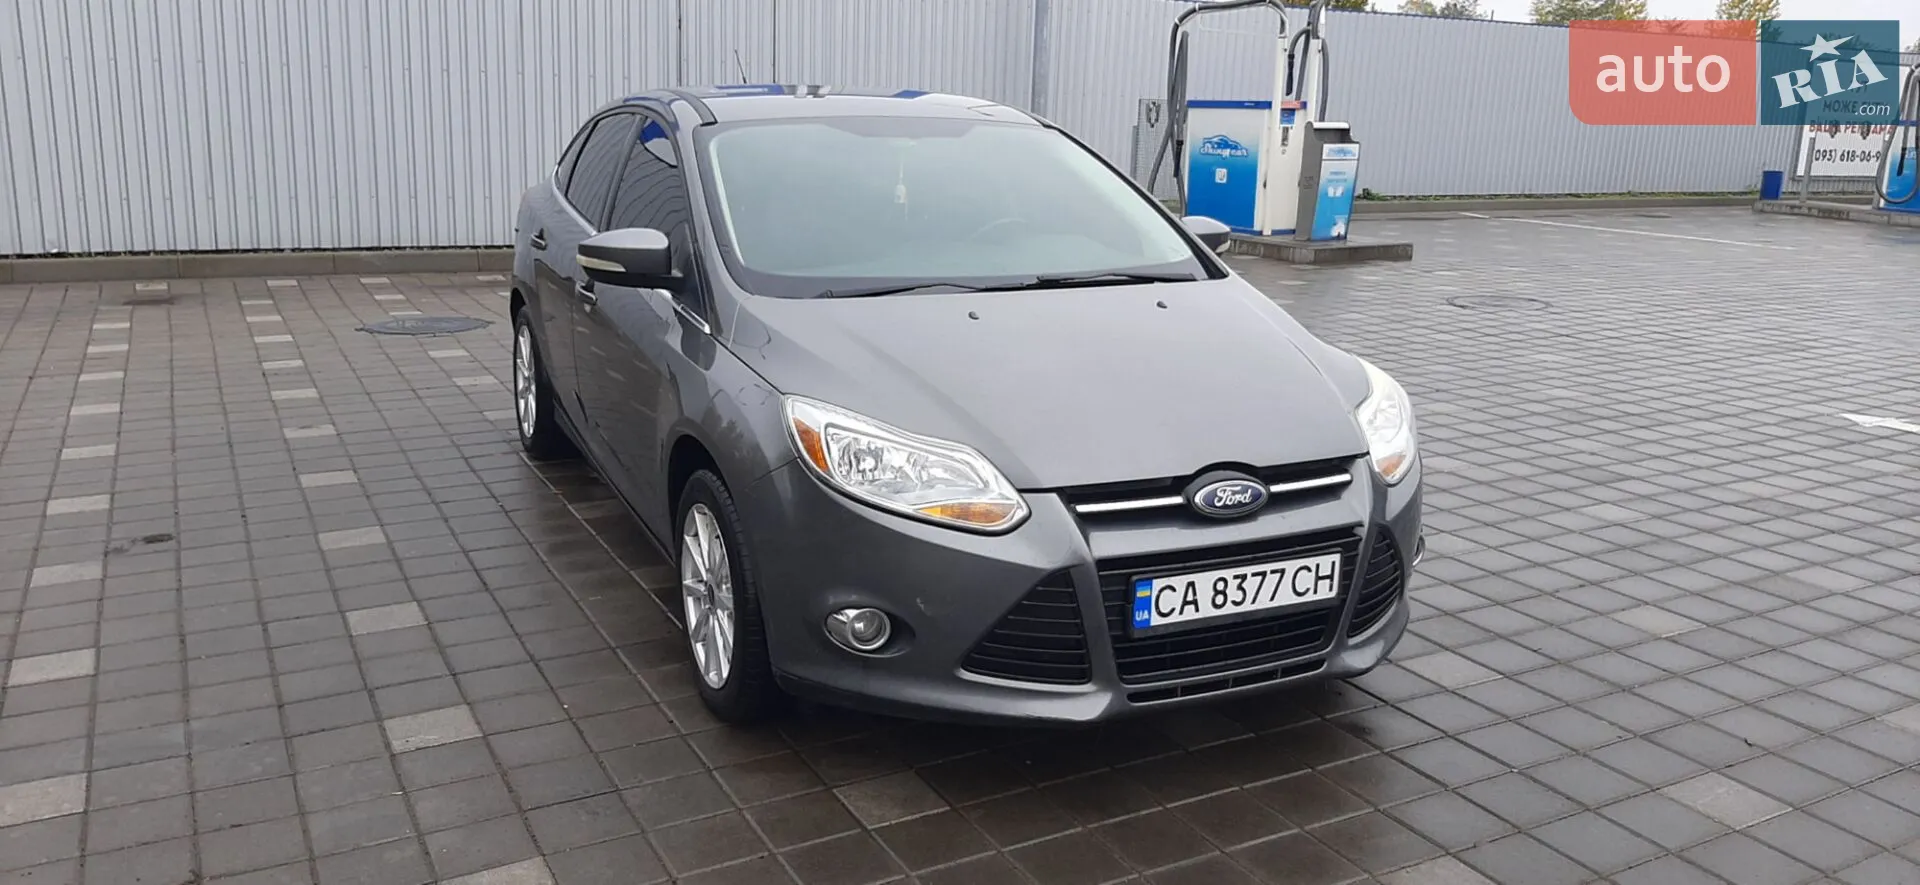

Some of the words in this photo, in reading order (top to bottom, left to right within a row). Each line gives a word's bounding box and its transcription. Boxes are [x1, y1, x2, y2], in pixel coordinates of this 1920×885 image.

[1844, 120, 1894, 135] РЕКАМА
[1813, 148, 1837, 164] 093)
[1839, 149, 1881, 163] 618-06-9
[1214, 486, 1252, 507] Ford
[1154, 580, 1200, 618] CA
[1211, 567, 1287, 610] 8377
[1291, 560, 1336, 598] CH
[1135, 610, 1149, 621] UA
